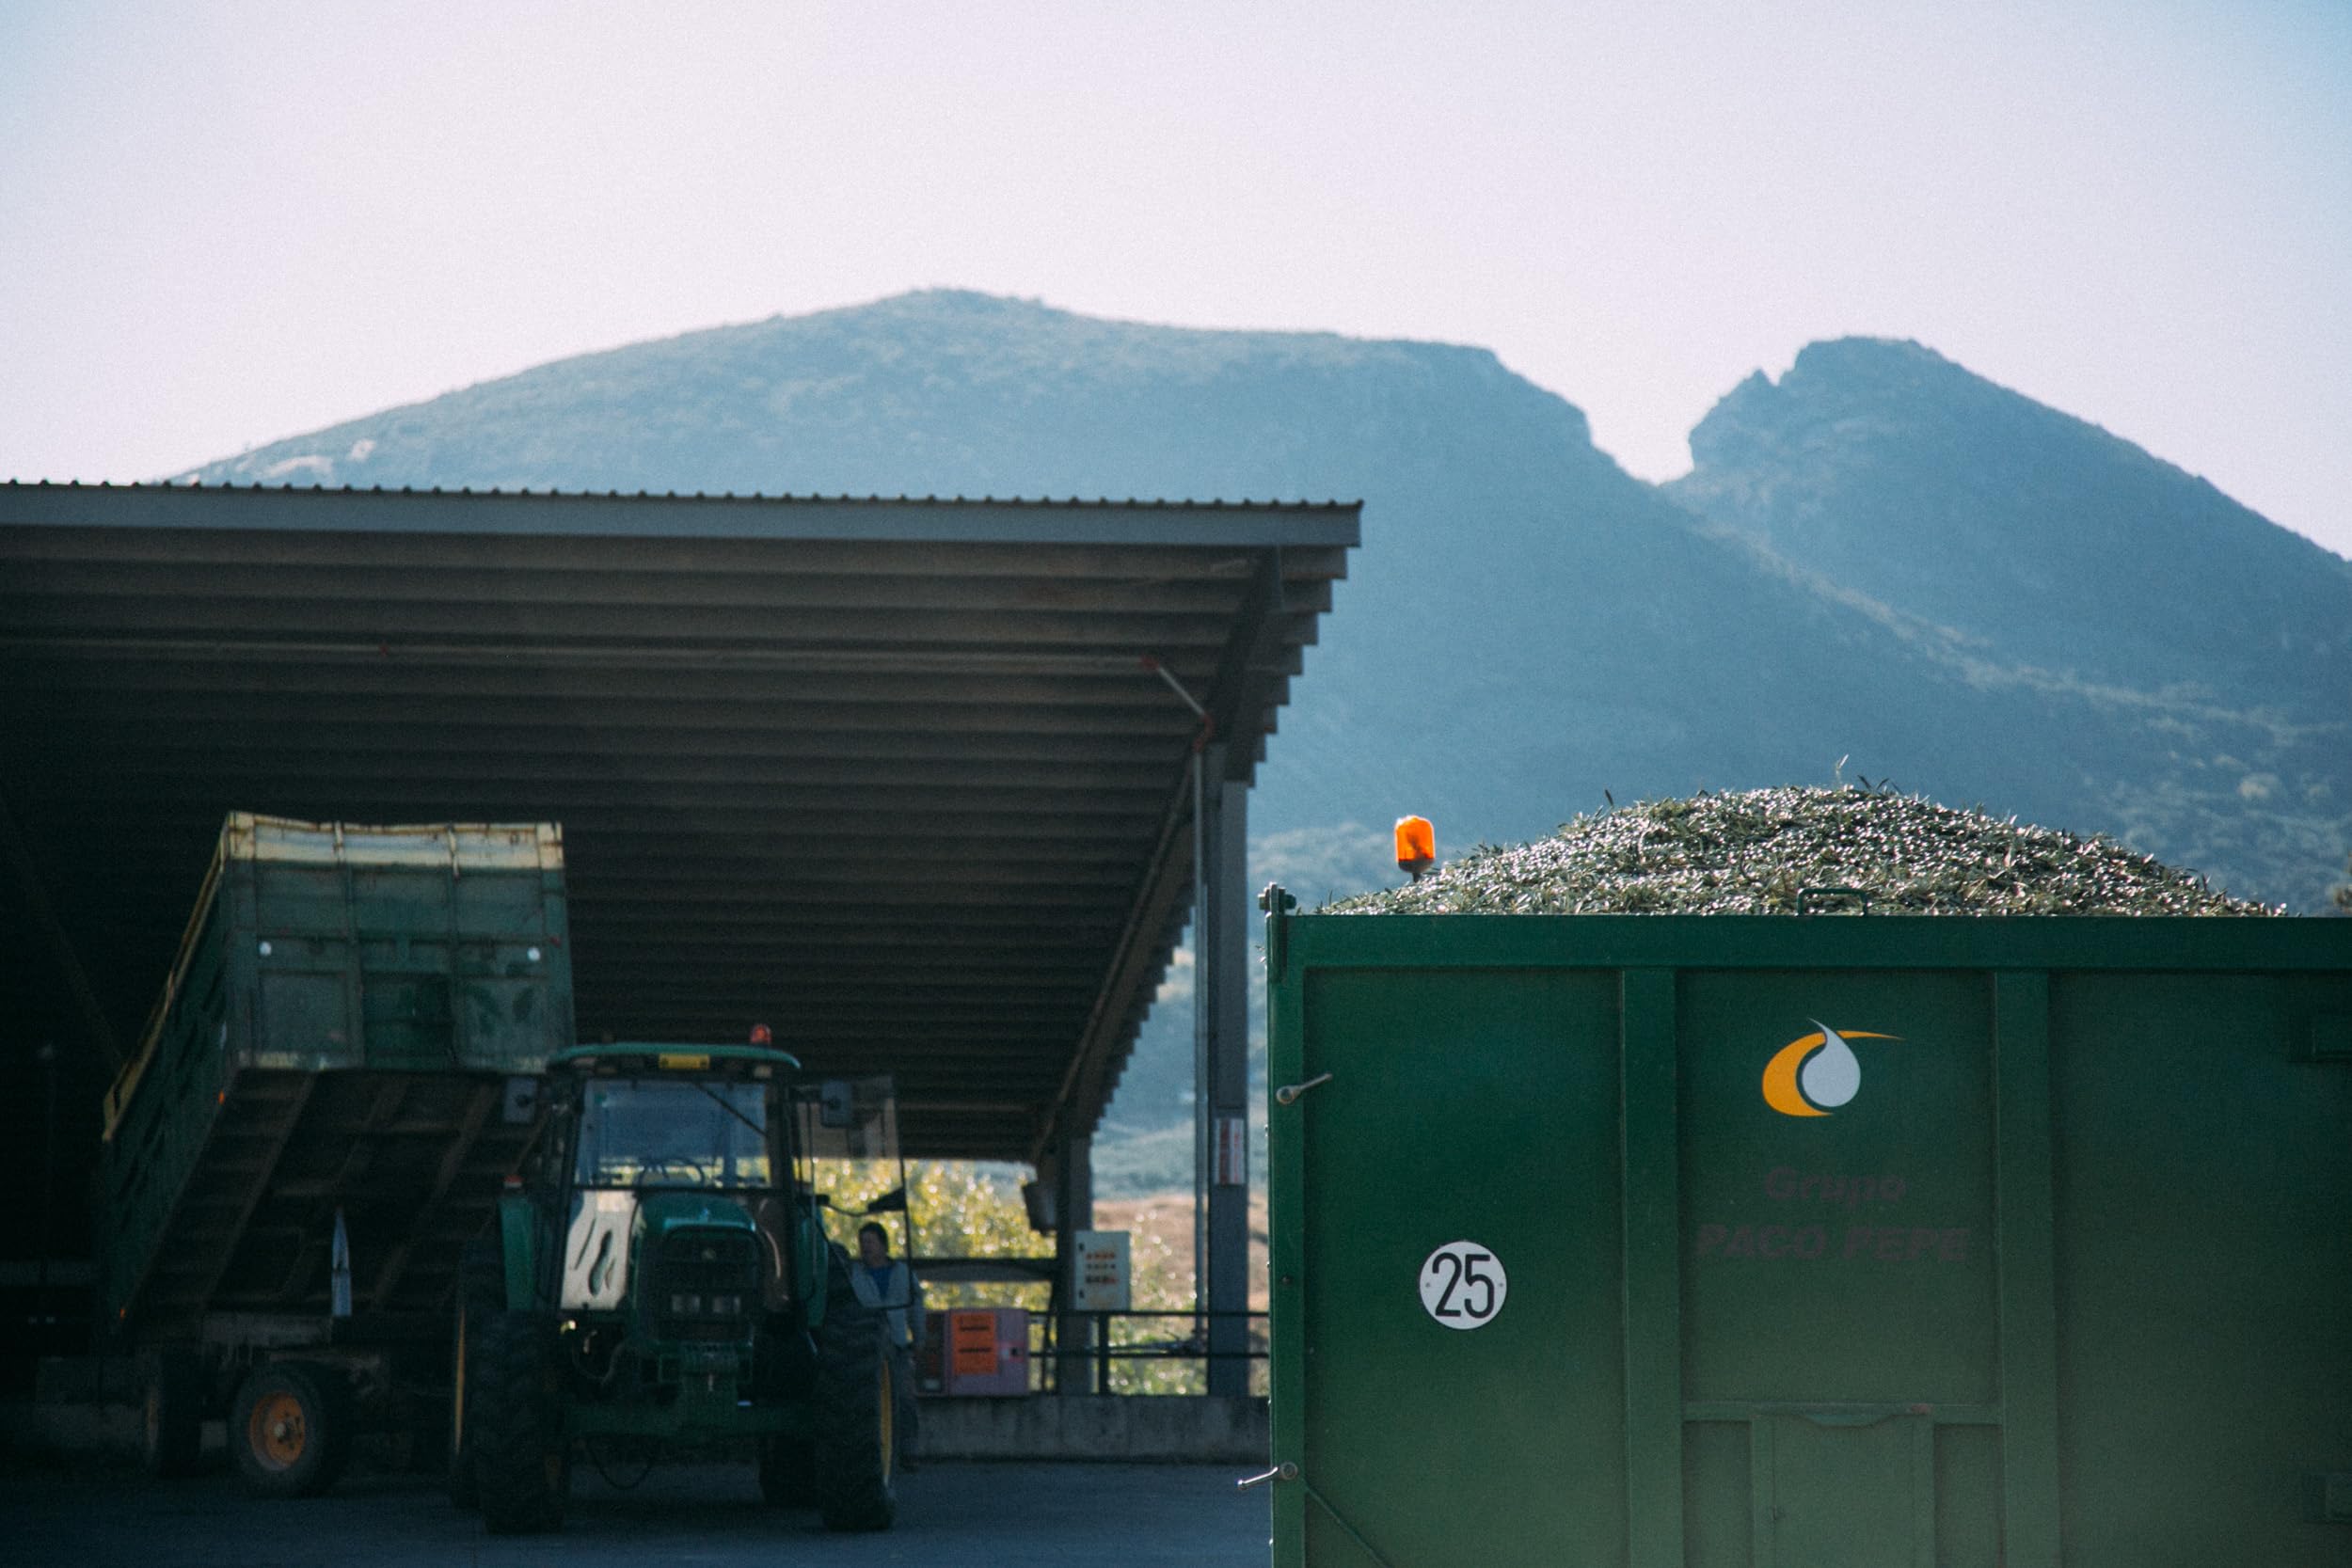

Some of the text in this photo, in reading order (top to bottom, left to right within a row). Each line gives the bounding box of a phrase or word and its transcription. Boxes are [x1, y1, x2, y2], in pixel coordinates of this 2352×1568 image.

[1762, 1166, 1909, 1212] Grupo
[1694, 1223, 1973, 1261] PACO PEPE
[1431, 1252, 1495, 1319] 25
